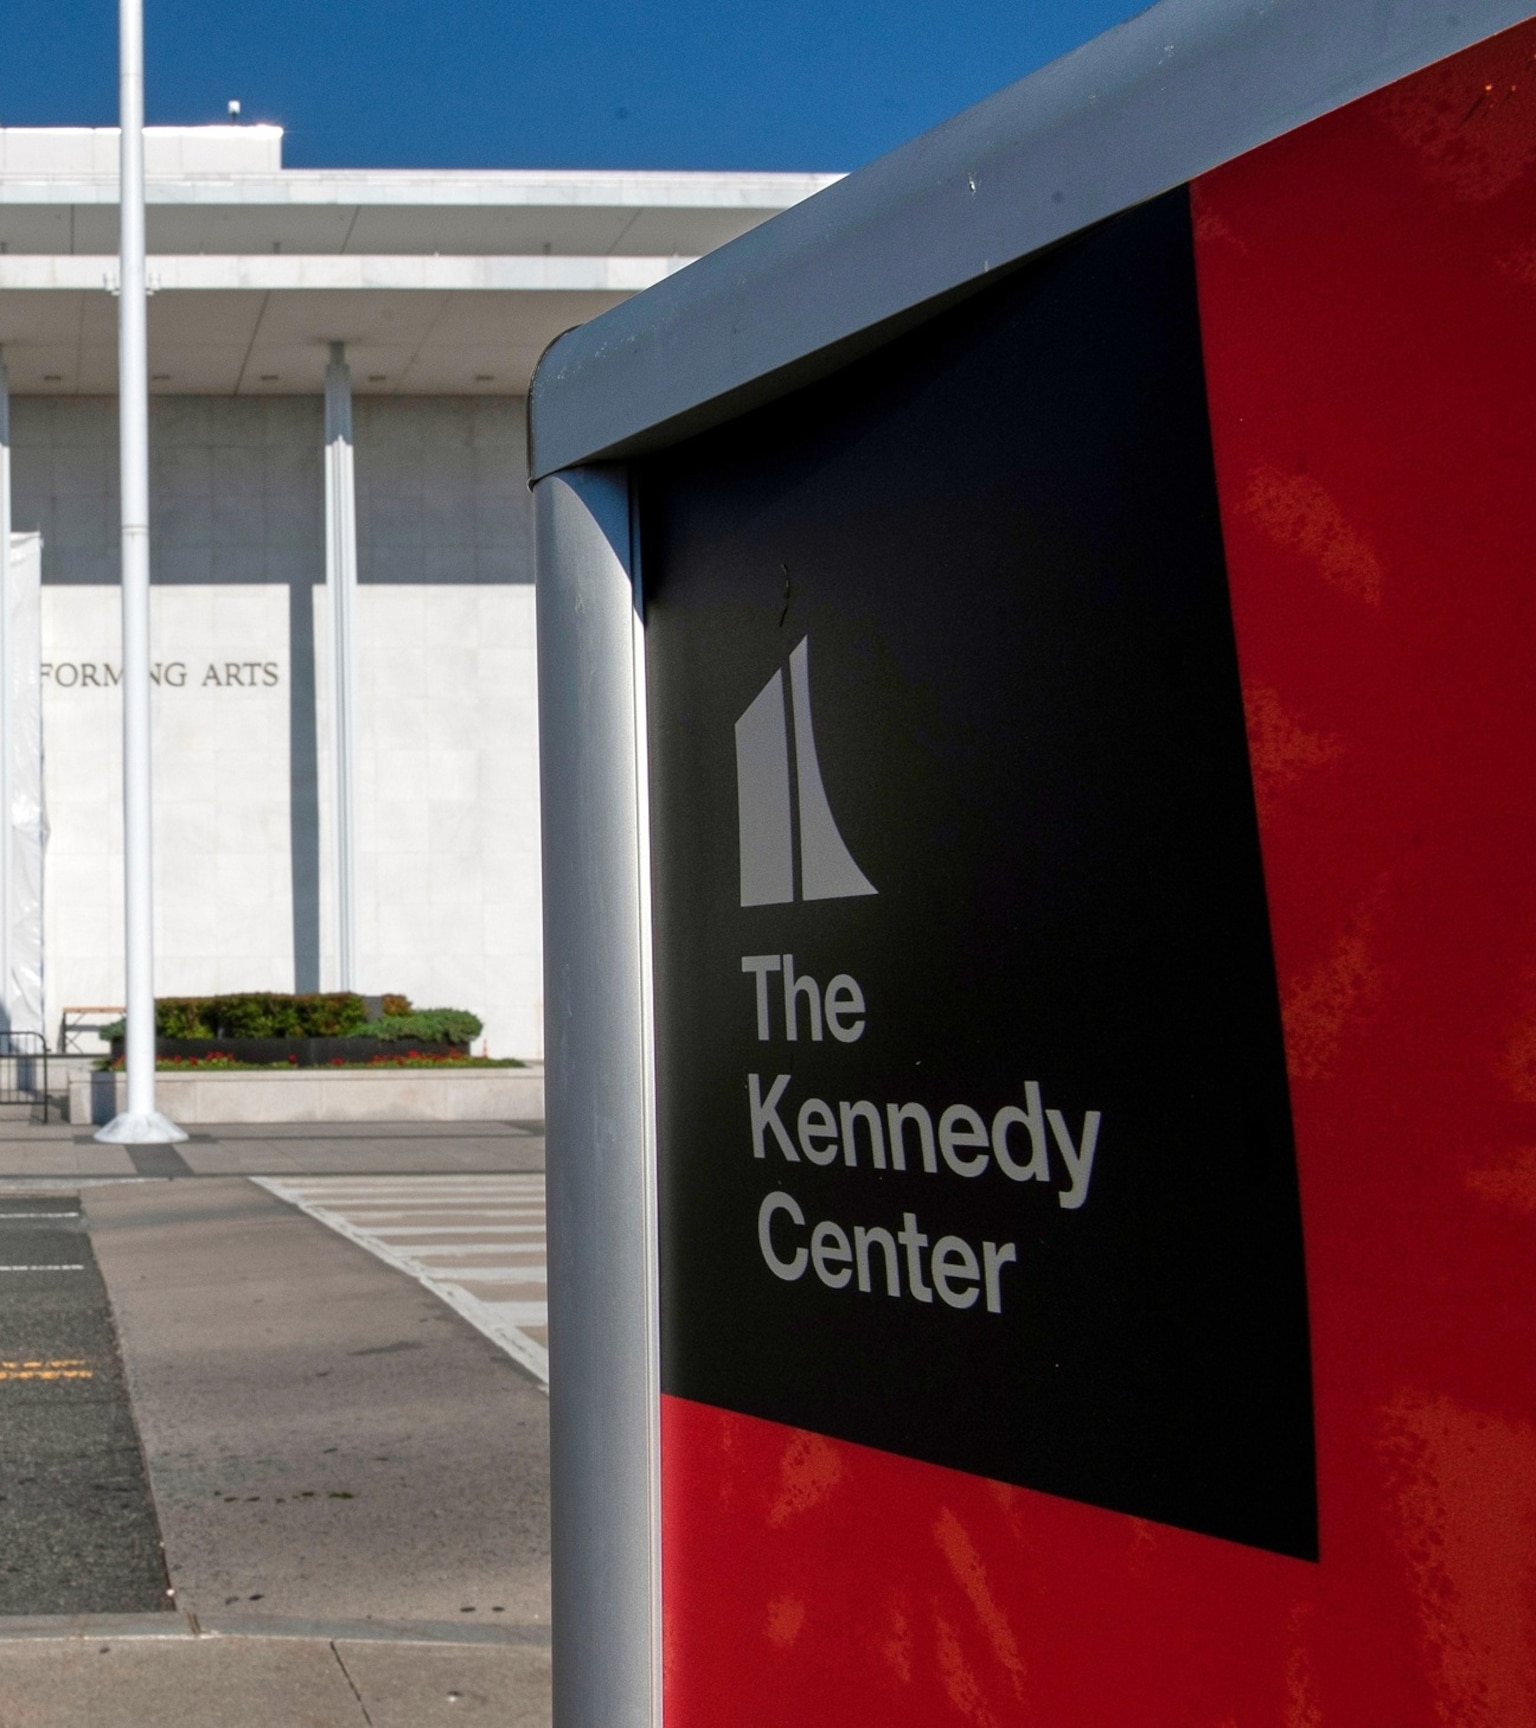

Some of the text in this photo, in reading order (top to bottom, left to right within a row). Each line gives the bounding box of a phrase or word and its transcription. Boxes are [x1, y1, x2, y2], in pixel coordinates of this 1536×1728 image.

[201, 662, 279, 687] ARTS
[741, 954, 866, 1043] The
[748, 1073, 1101, 1209] Kennedy
[758, 1190, 1016, 1314] Center
